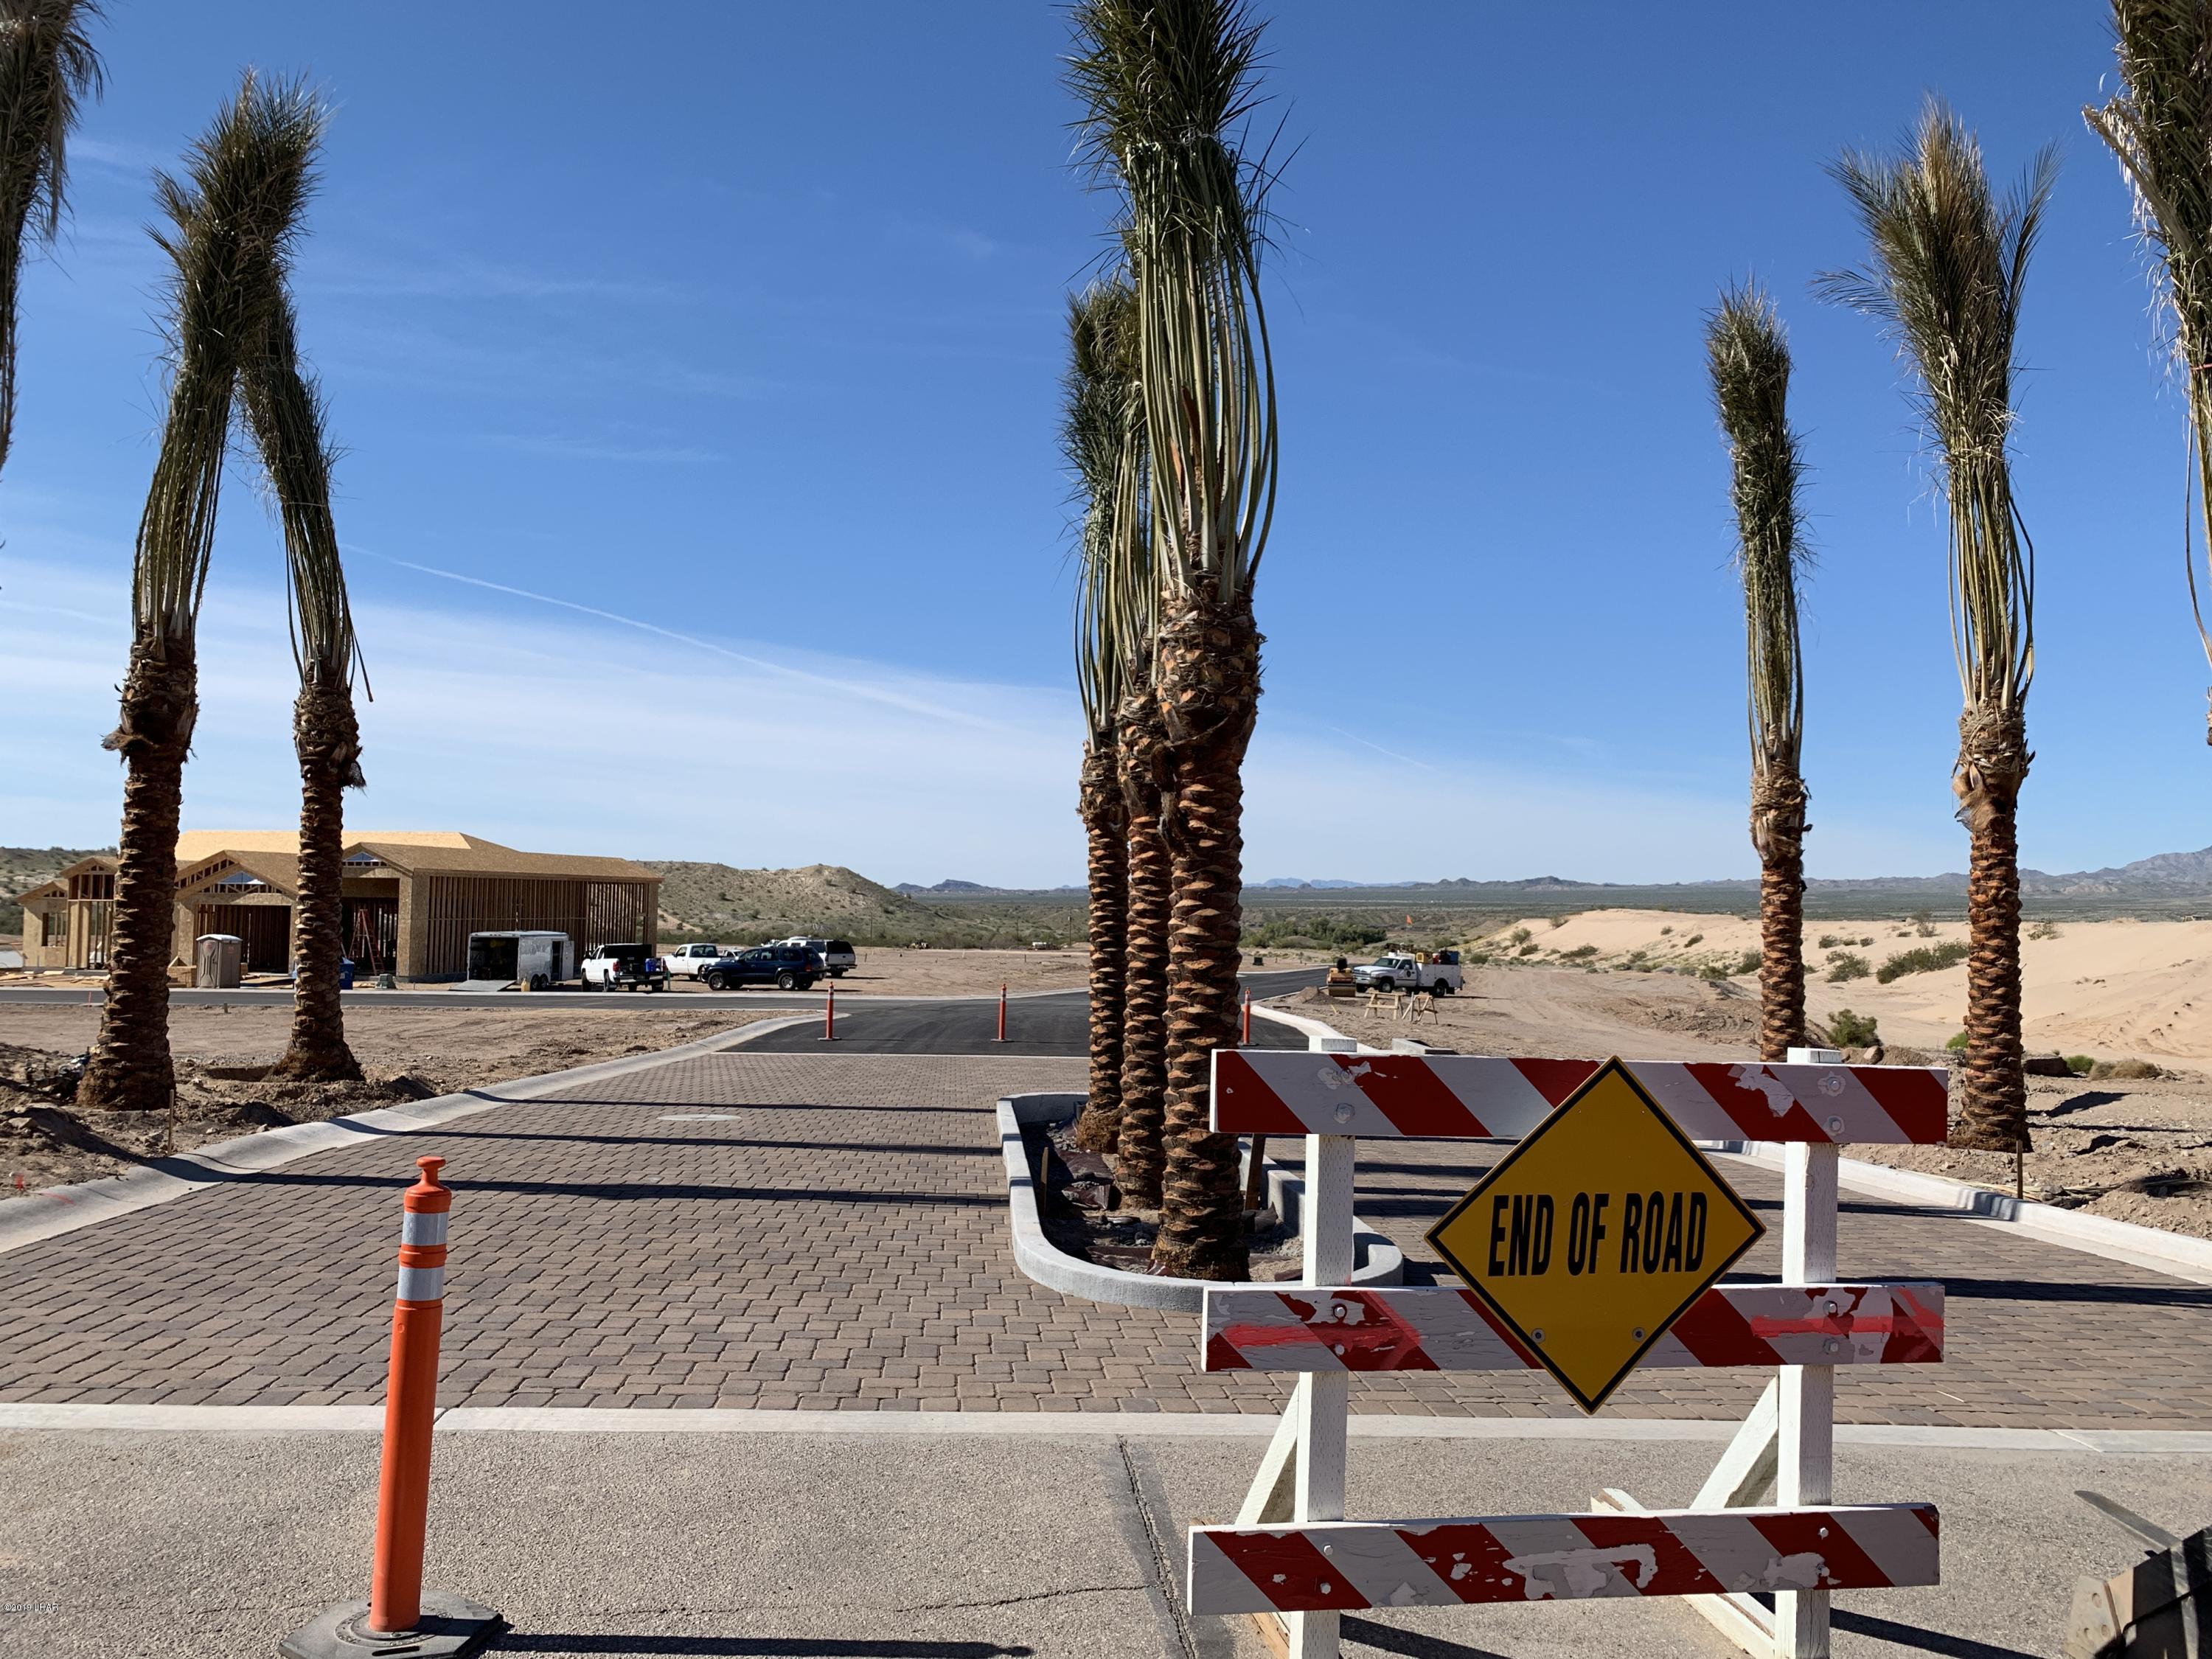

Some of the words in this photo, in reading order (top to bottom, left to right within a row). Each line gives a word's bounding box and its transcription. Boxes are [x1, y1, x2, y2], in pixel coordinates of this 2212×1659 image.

[1488, 1194, 1554, 1276] END
[1568, 1192, 1610, 1276] OF
[1620, 1191, 1708, 1275] ROAD
